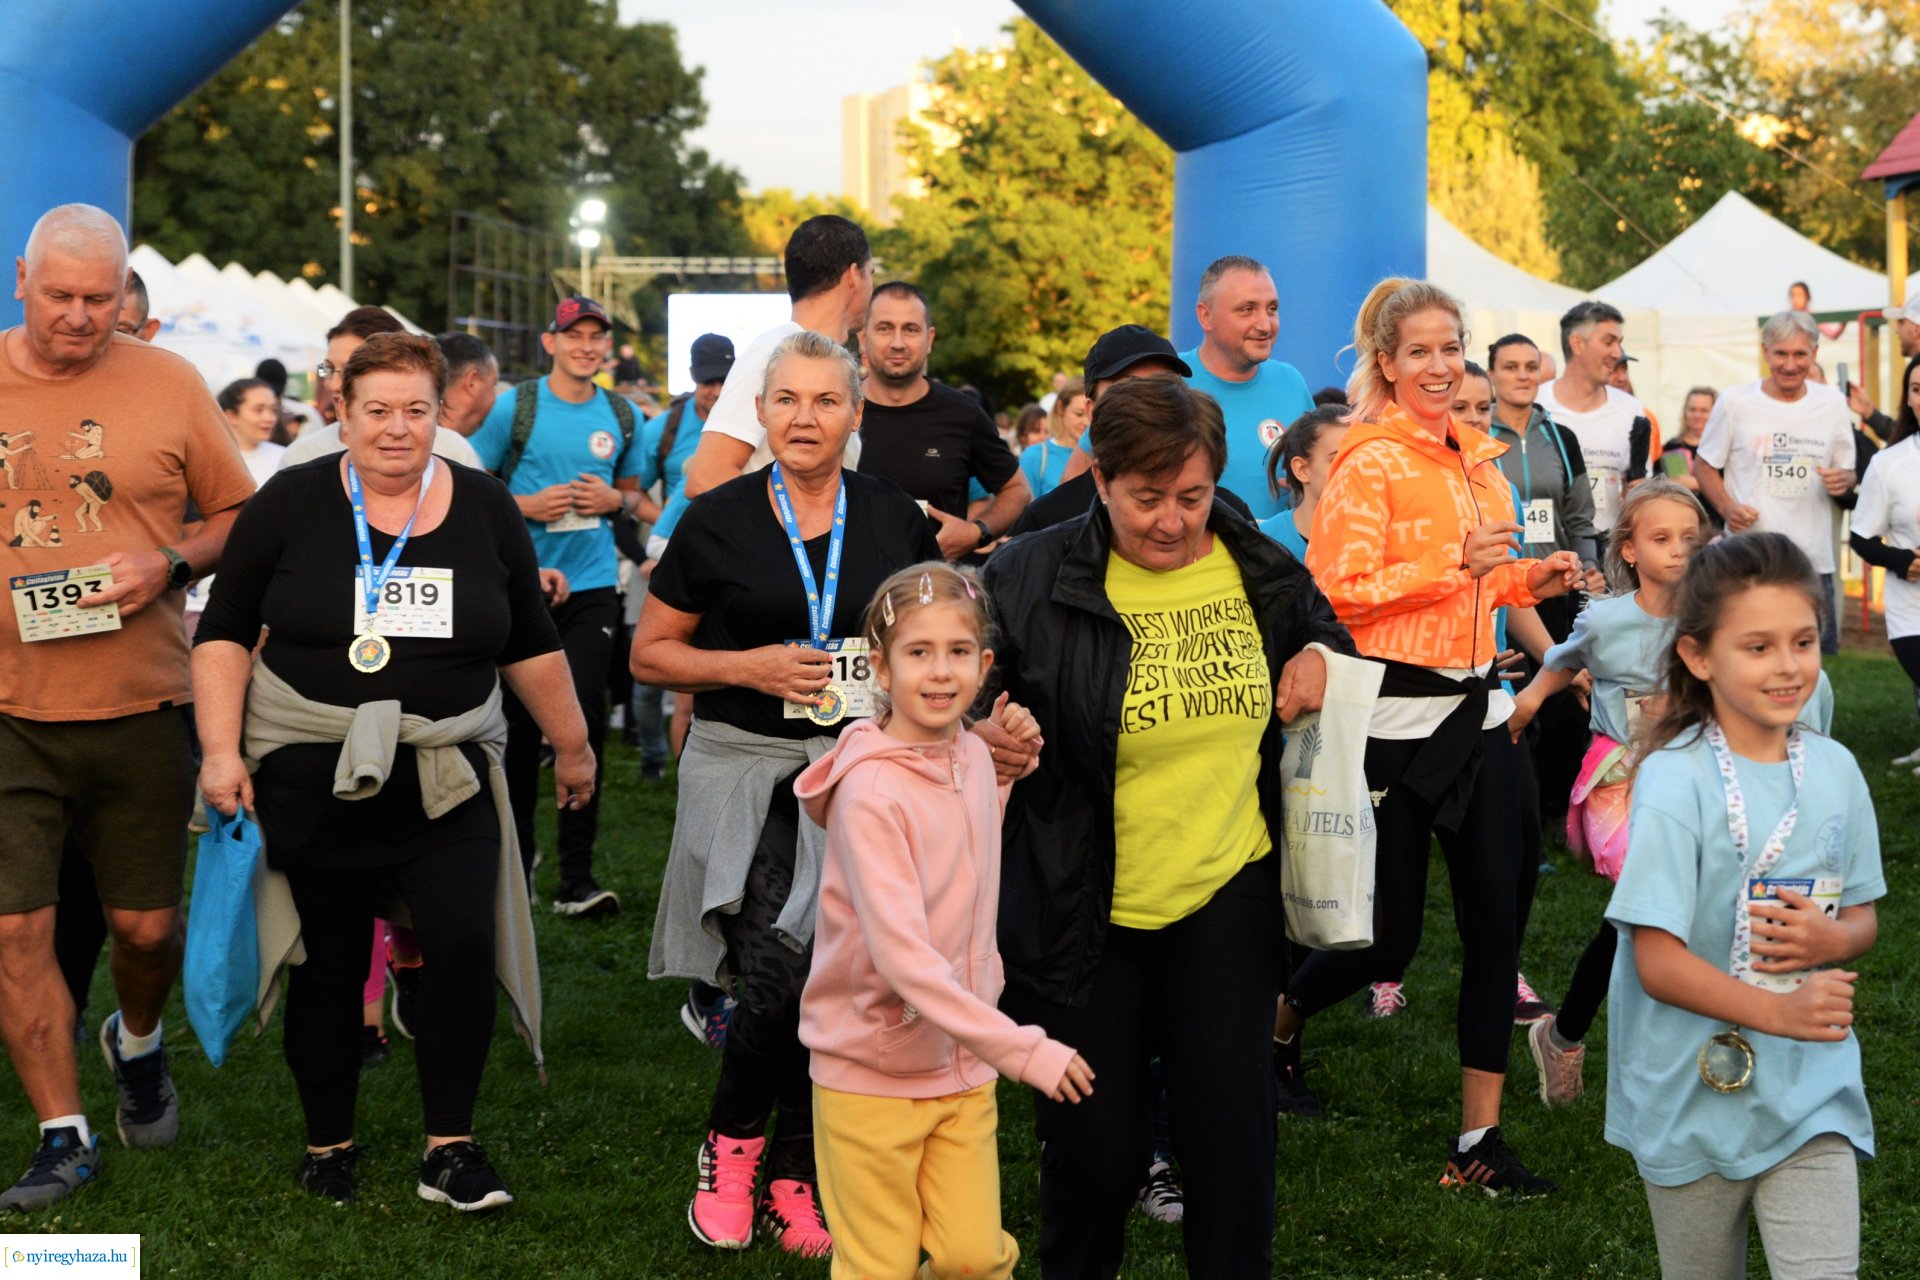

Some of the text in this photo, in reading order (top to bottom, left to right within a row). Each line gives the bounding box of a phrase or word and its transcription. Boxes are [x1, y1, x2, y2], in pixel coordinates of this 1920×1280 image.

[1583, 448, 1621, 458] Electrolux
[1767, 465, 1807, 479] 1540
[1527, 510, 1549, 523] 48
[24, 580, 103, 611] 1393
[827, 655, 871, 682] 18
